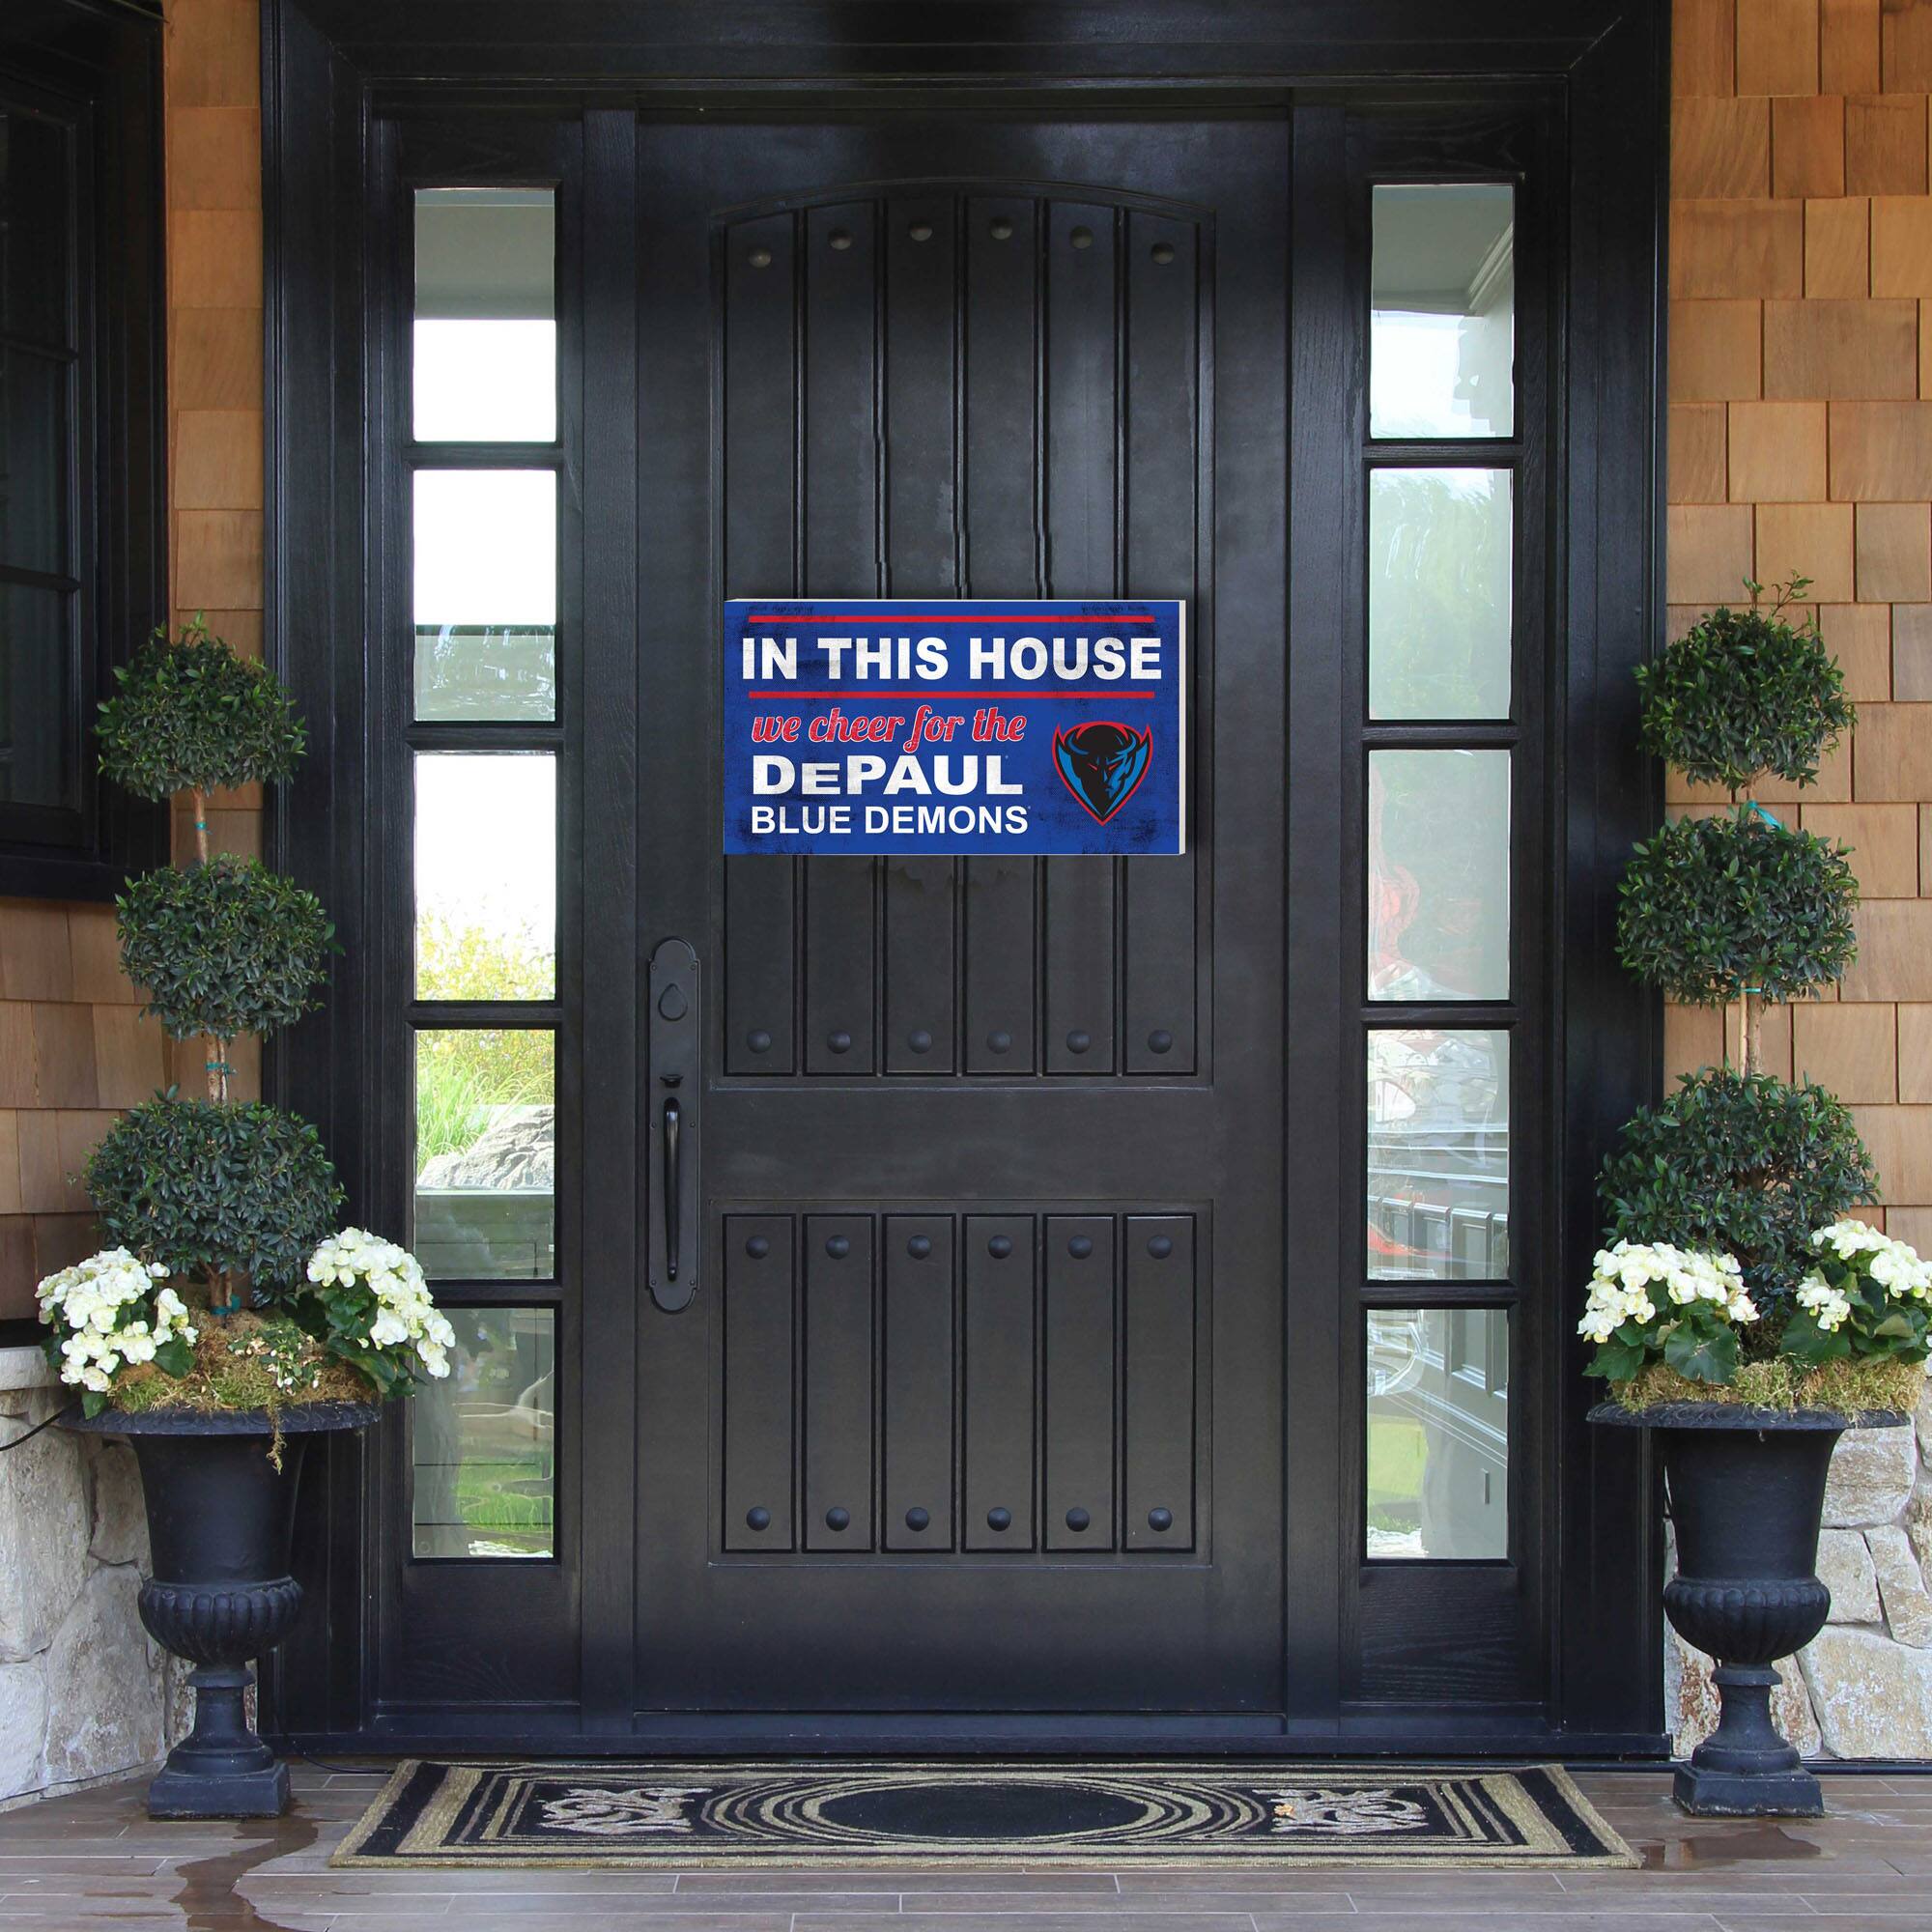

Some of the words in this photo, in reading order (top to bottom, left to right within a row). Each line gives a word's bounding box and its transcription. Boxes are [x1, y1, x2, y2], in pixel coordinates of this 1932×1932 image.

[742, 638, 797, 680] IN
[817, 638, 949, 680] THIS
[969, 638, 1162, 680] HOUSE
[752, 714, 799, 743] we
[809, 707, 904, 743] cheer
[903, 704, 965, 753] for
[972, 706, 1027, 743] the
[752, 806, 851, 835] BLUE
[865, 805, 1029, 835] DEMONS
